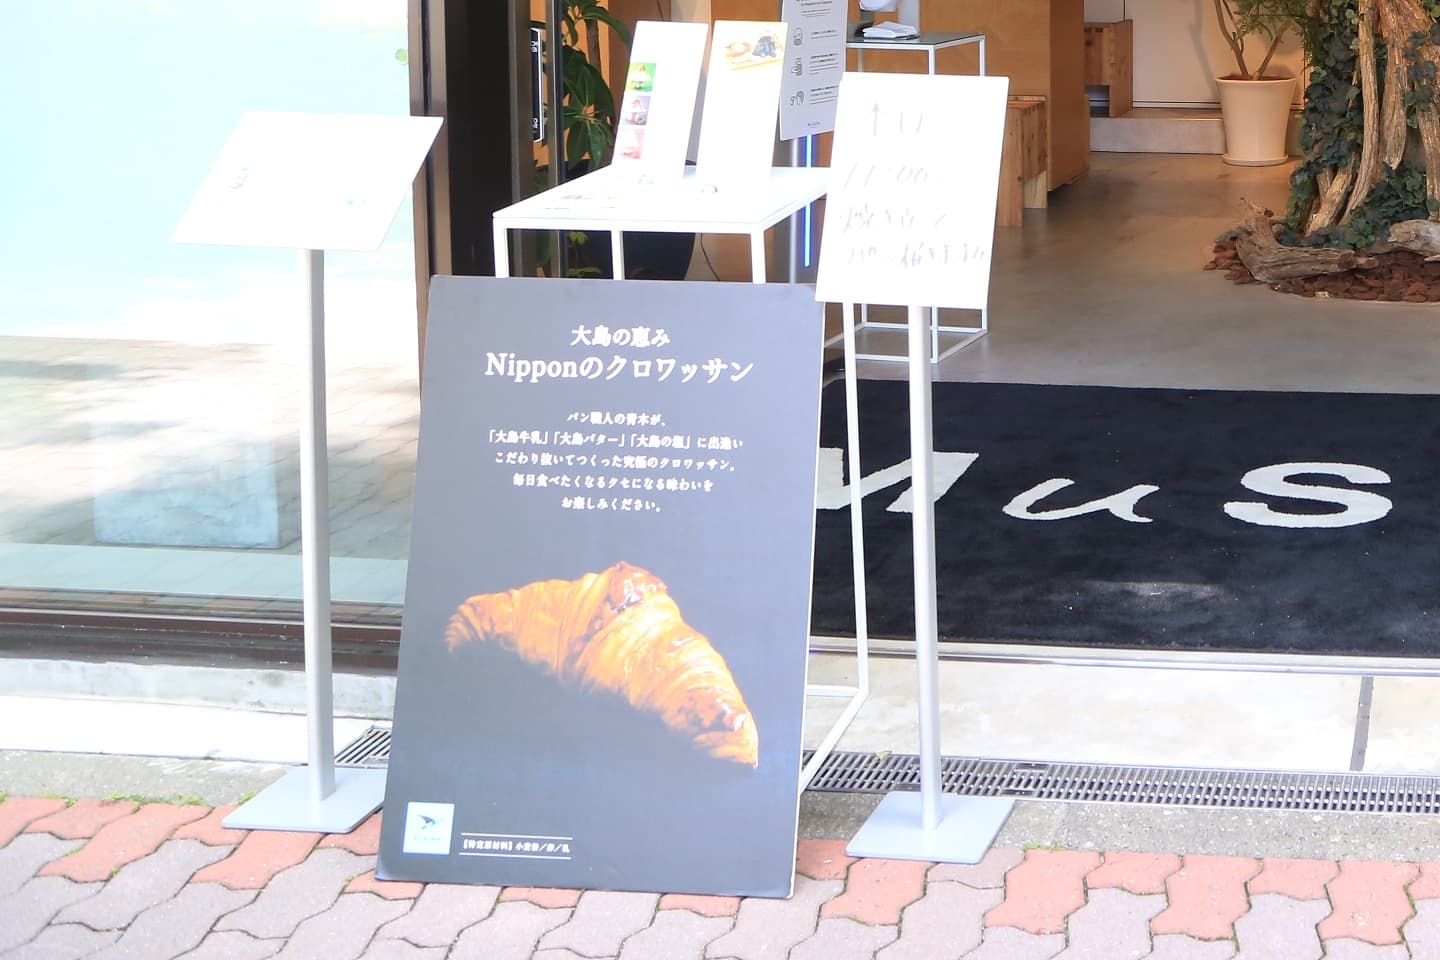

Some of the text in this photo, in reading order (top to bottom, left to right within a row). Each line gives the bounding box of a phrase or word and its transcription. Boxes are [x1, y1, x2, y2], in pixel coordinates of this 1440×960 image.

[570, 325, 670, 348] 大島の恵み
[484, 352, 755, 384] Nipponのクロワッサン
[561, 496, 661, 513] お楽しみください。
